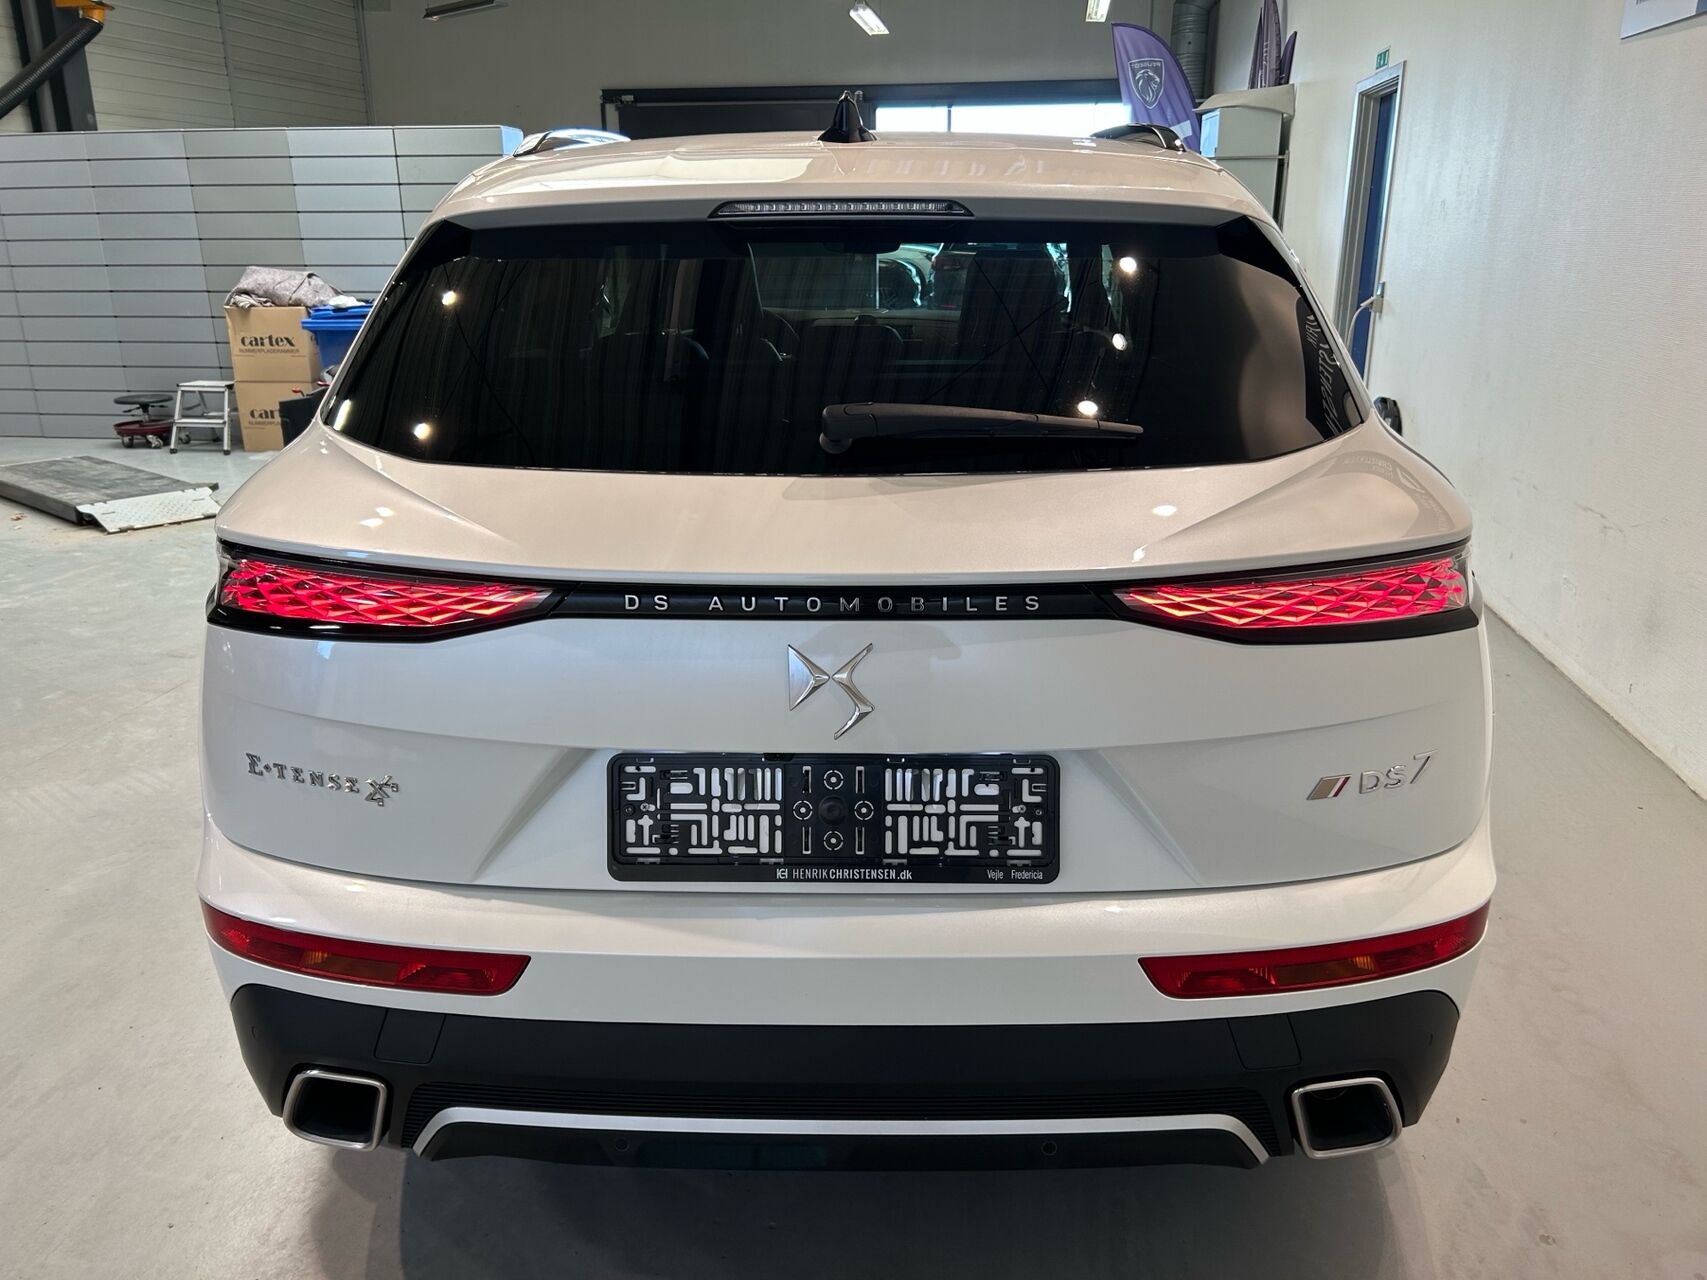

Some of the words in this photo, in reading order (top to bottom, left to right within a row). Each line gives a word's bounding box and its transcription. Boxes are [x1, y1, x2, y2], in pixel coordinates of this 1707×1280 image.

[240, 334, 296, 347] cartex
[624, 595, 669, 611] DS
[708, 594, 1040, 612] AUTOMOBILES
[792, 868, 913, 880] HENRIKCHRISTENSEN.dk
[986, 869, 1004, 880] Vejle
[1011, 869, 1043, 880] Fredericia
